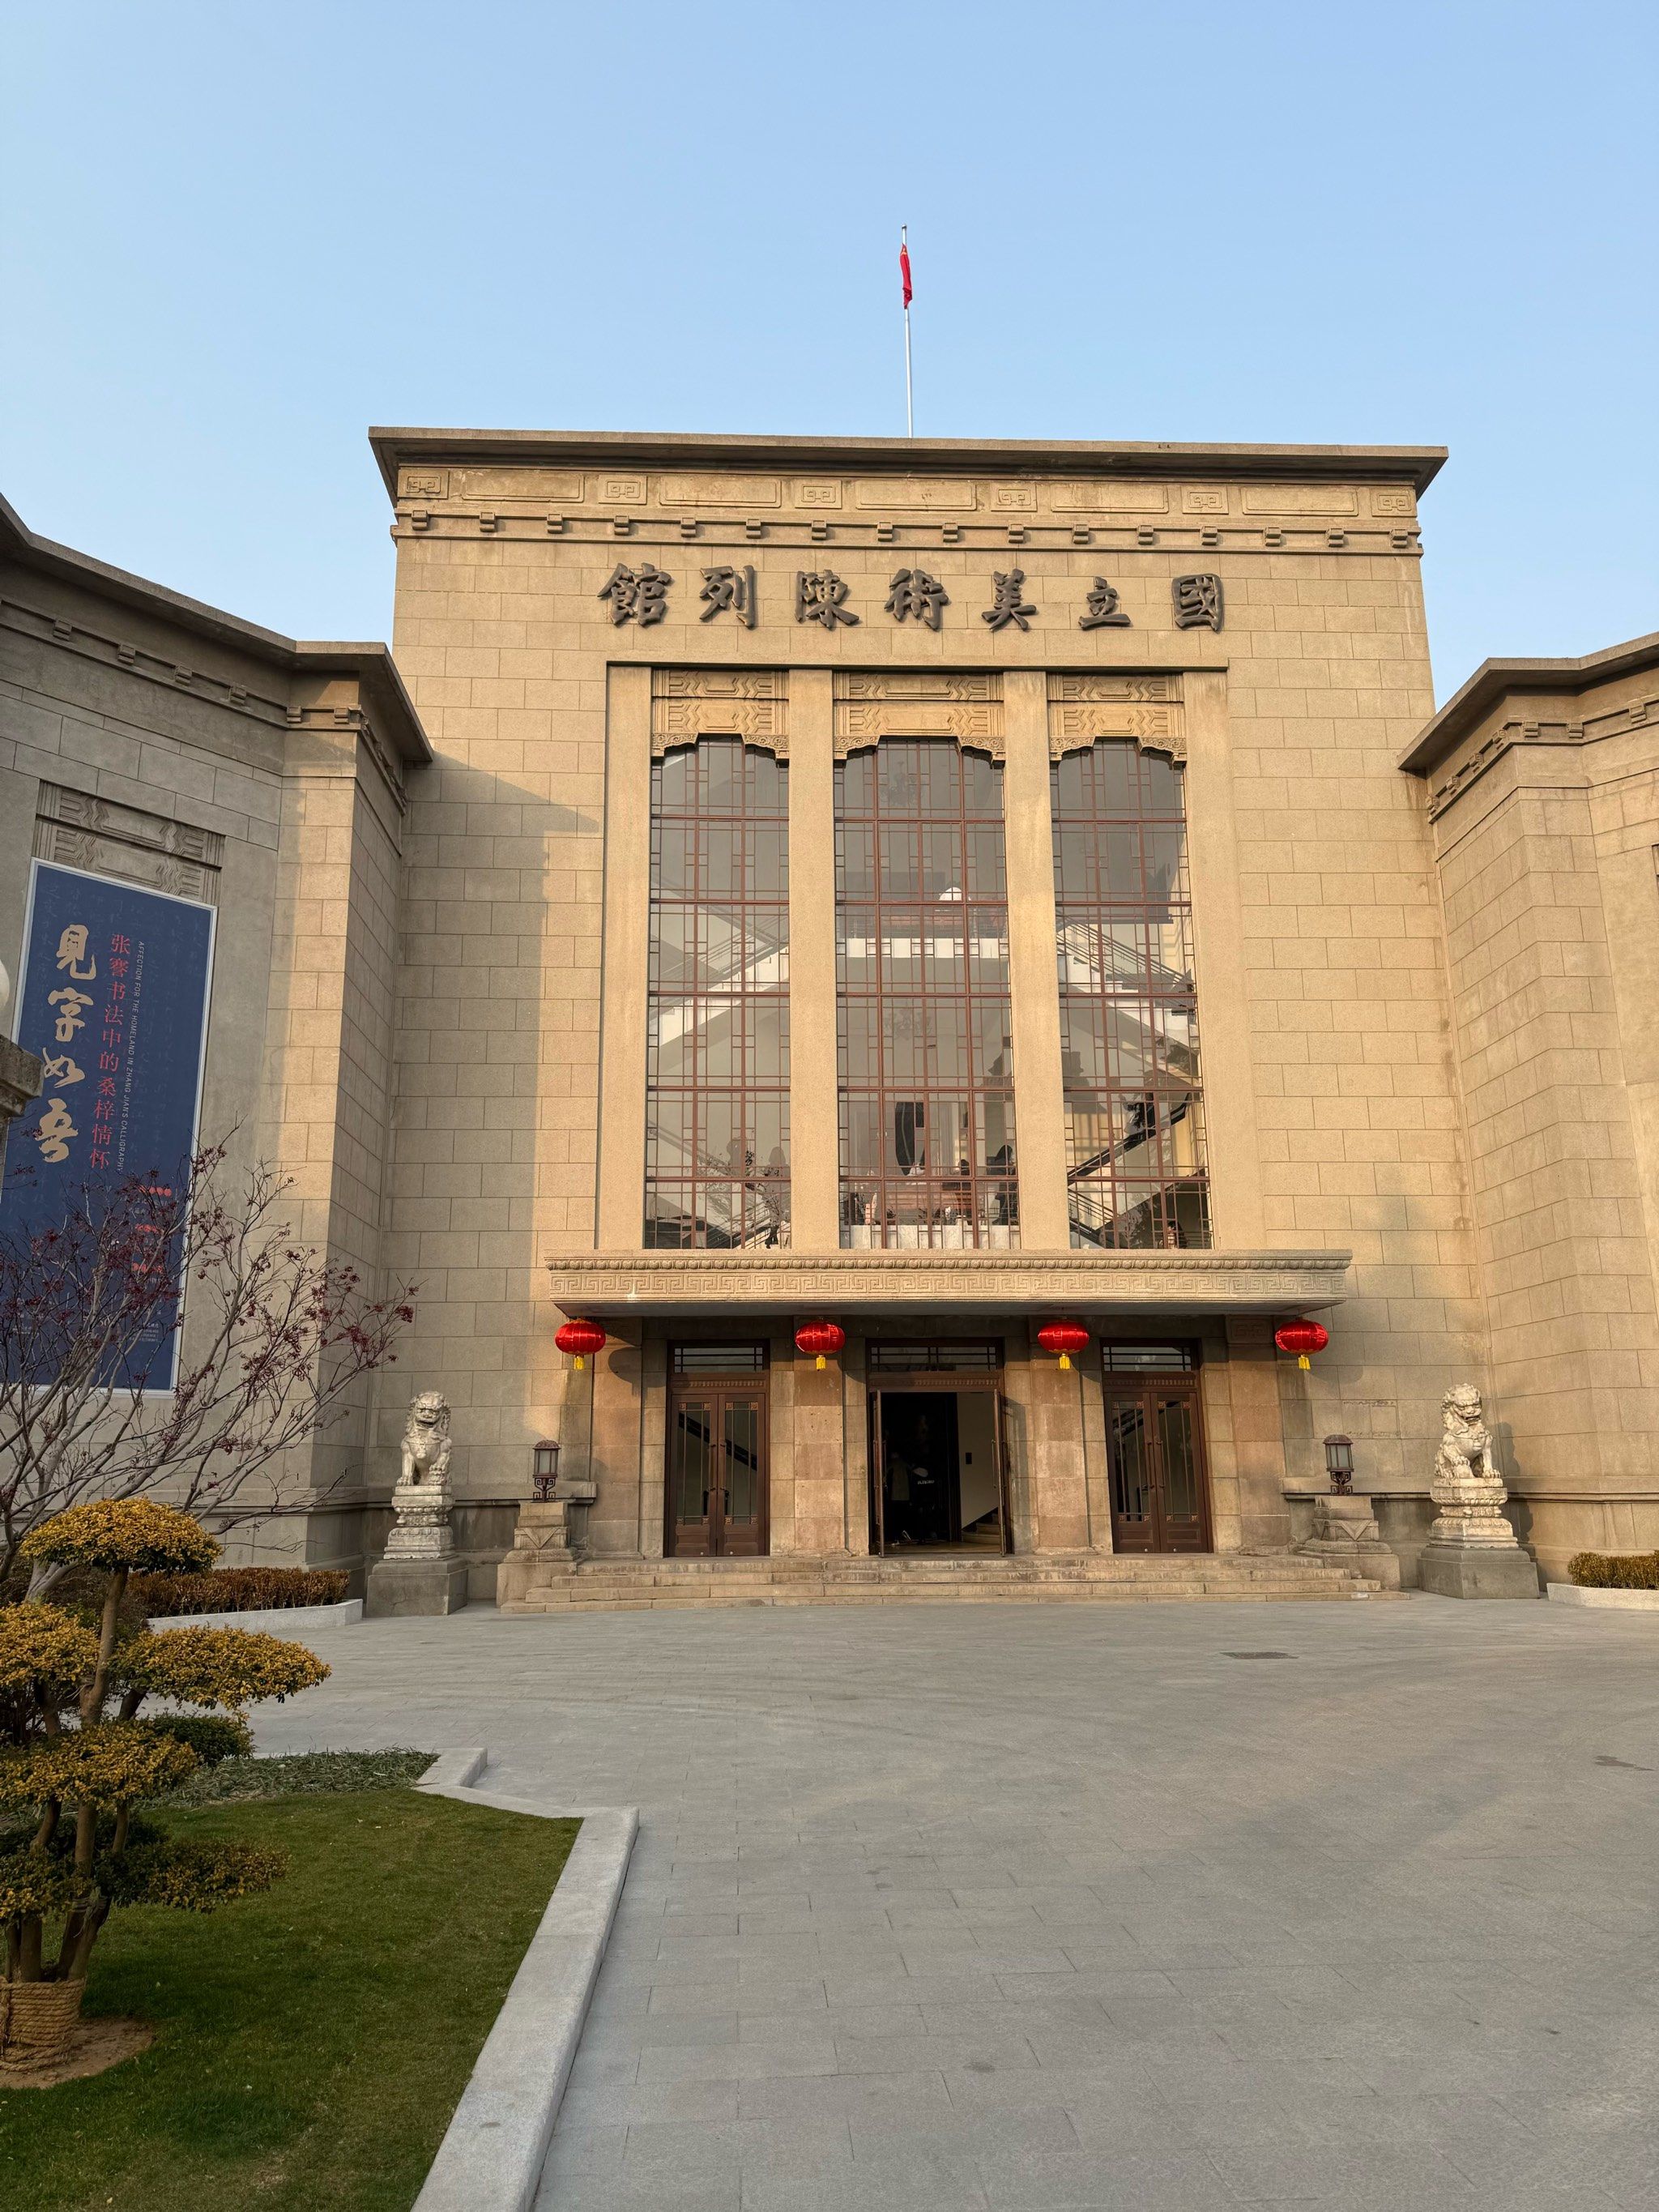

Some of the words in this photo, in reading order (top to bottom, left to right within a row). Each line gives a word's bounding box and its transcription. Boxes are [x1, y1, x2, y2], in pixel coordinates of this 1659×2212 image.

[134, 941, 145, 980] AFFECTION
[133, 981, 141, 997] FOR
[131, 1000, 139, 1014] THE
[128, 1015, 138, 1055] HOMELAND
[124, 1067, 133, 1093] ZHANG
[117, 1120, 128, 1172] CALLIGRAPHY
